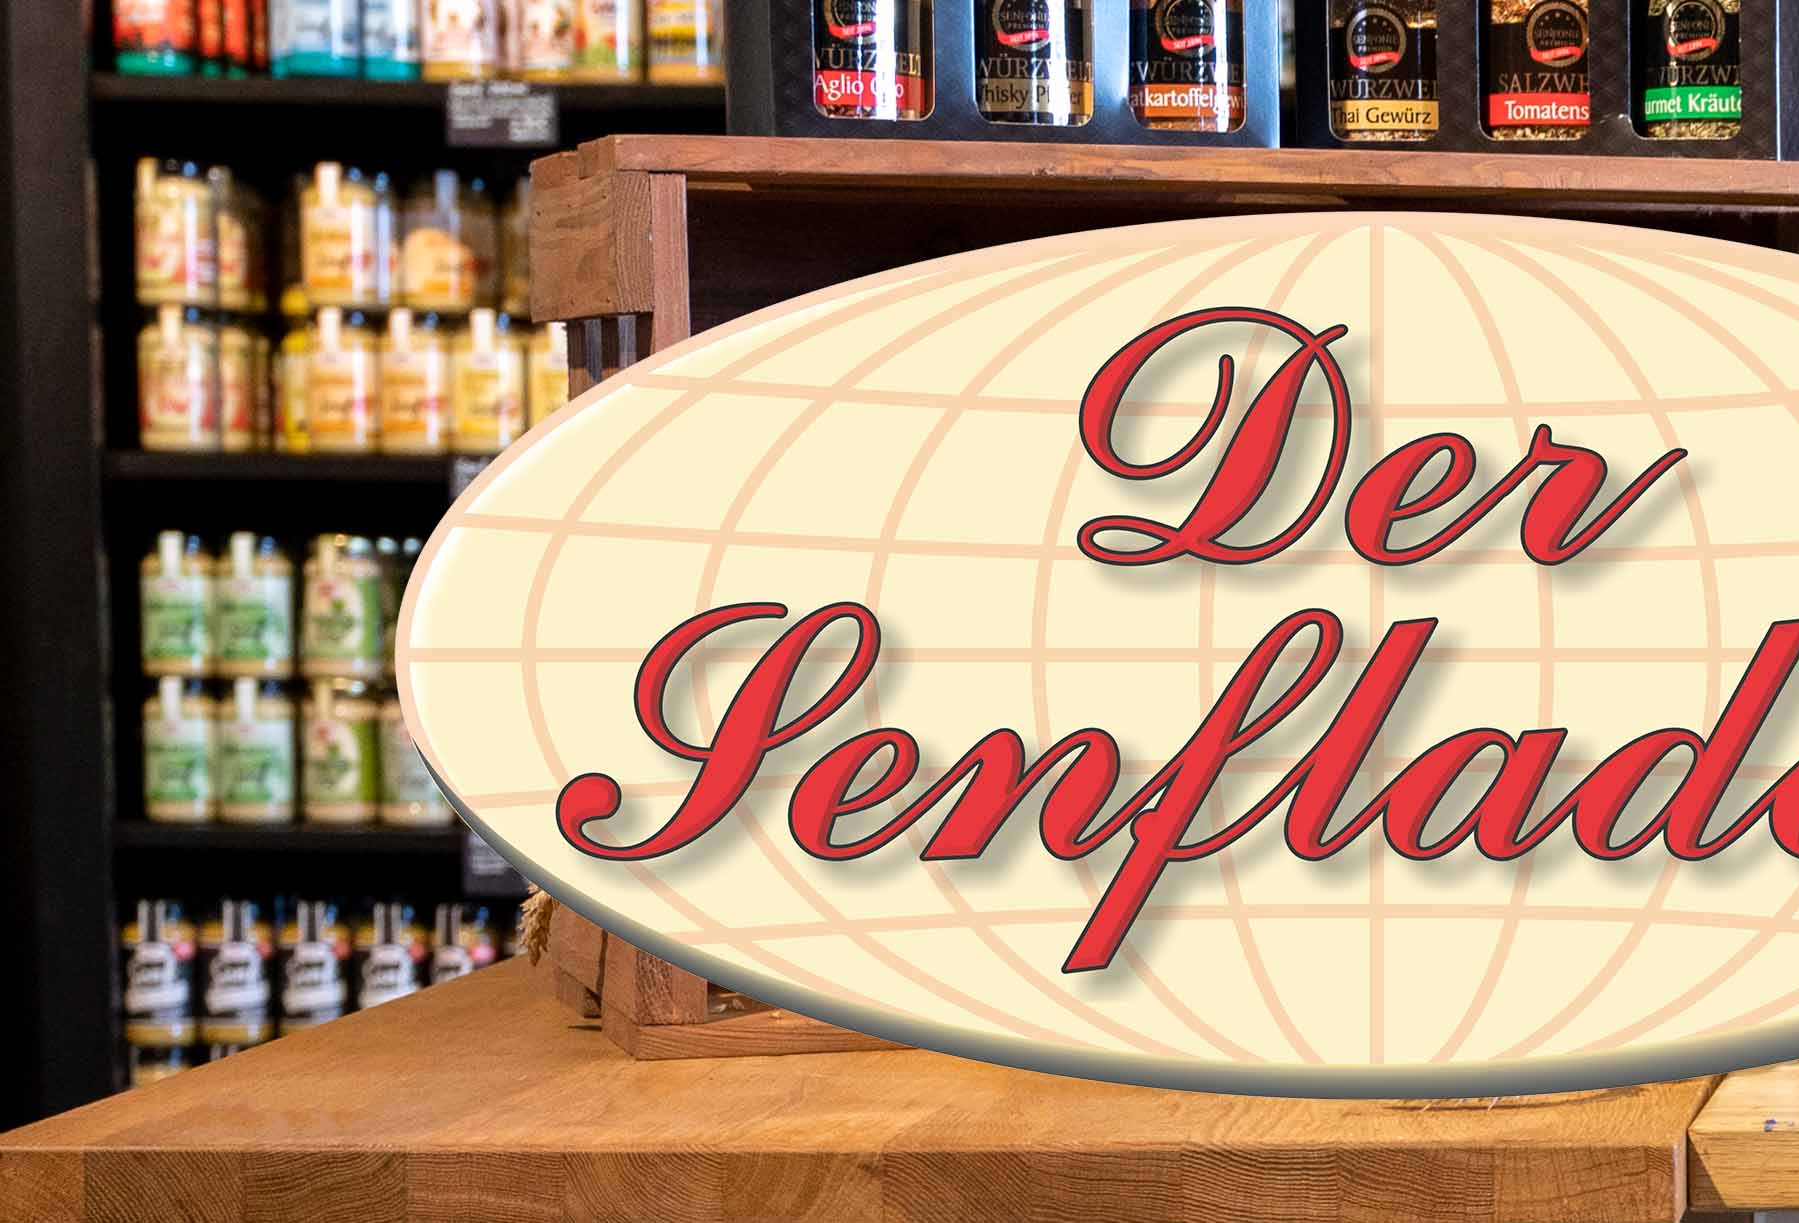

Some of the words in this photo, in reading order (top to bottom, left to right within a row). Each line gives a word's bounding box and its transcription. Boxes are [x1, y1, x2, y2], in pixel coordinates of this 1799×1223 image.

[815, 74, 864, 101] Aglio
[983, 84, 1029, 109] hisky
[1366, 106, 1432, 125] Gewürz
[1504, 100, 1590, 120] Tomatens
